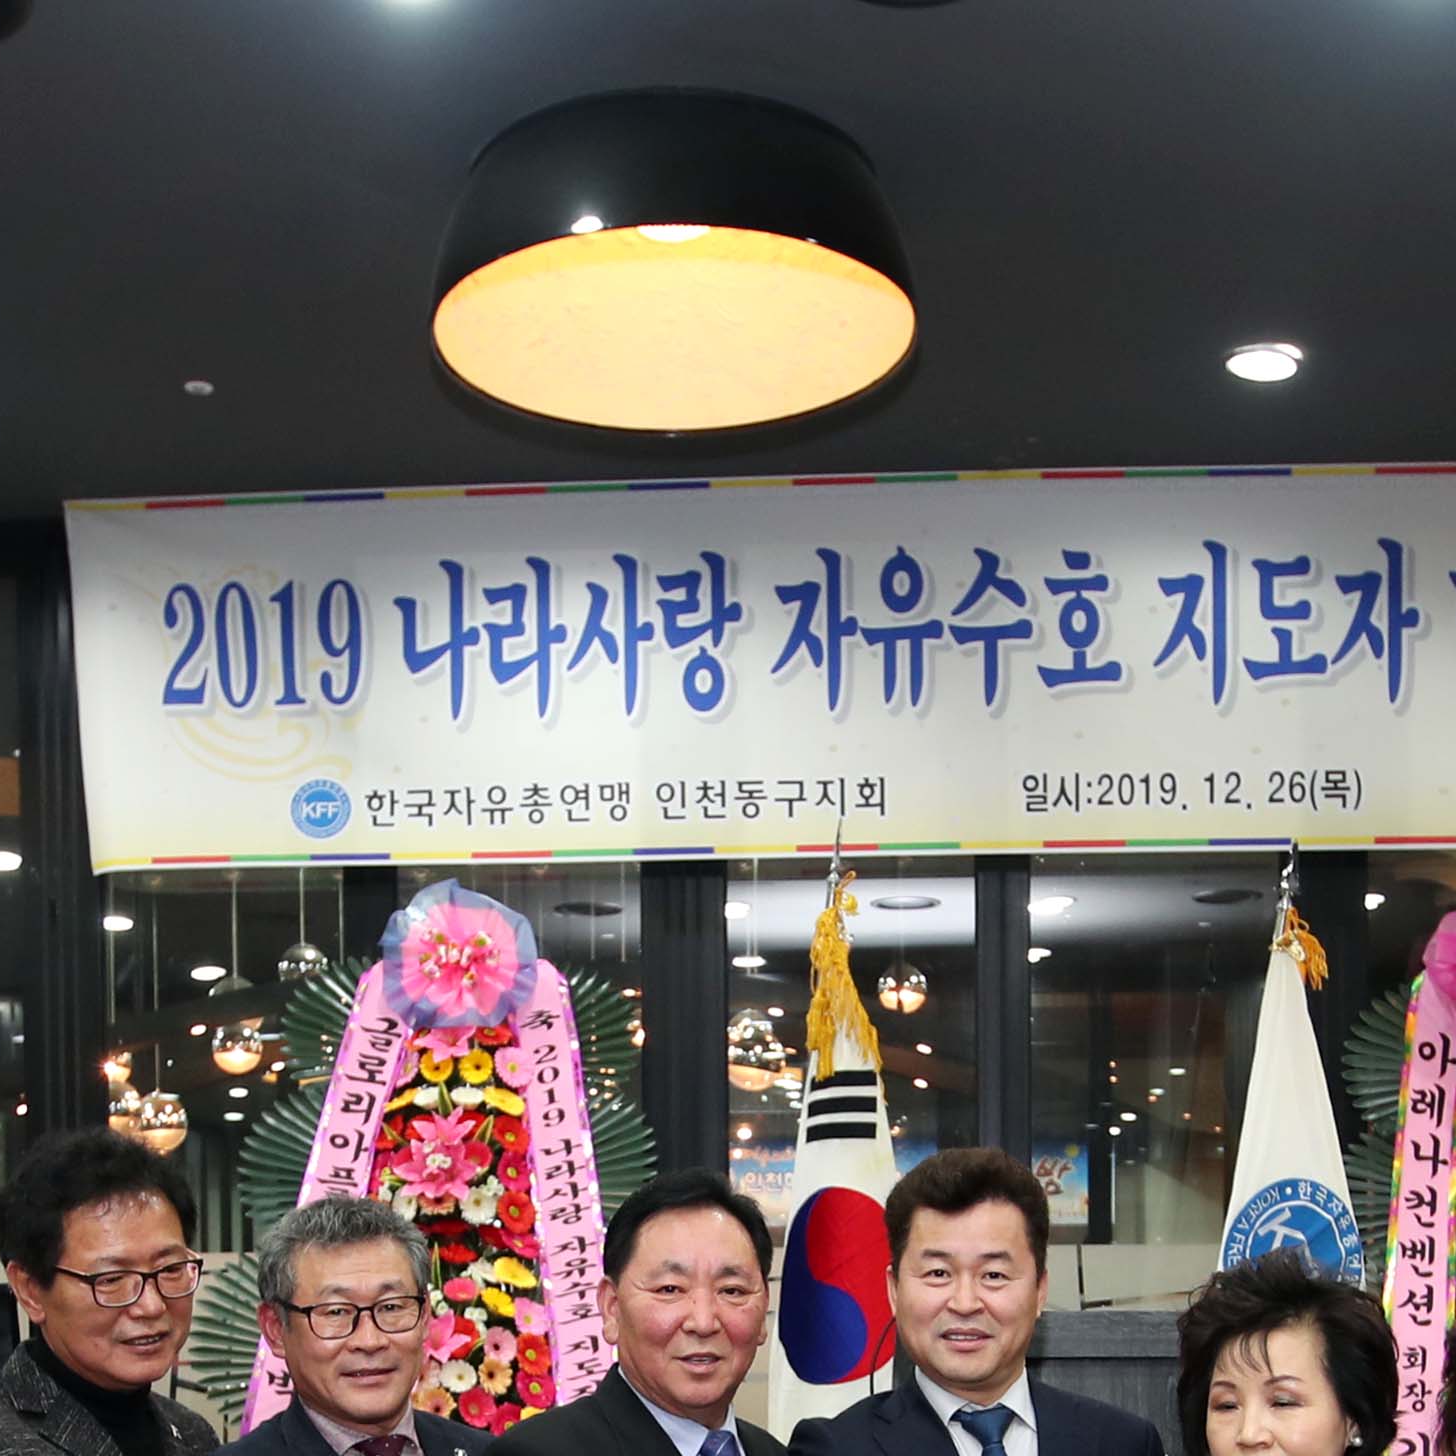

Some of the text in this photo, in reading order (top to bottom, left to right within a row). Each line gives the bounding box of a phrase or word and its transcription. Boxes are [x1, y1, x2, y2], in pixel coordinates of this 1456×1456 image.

[160, 577, 366, 708] 2019
[392, 548, 744, 721] 나라사랑
[770, 545, 1125, 714] 자유수호
[1153, 537, 1420, 706] 지도자
[300, 800, 343, 820] KFF
[365, 782, 633, 829] 한국자유총연맹
[655, 775, 889, 820] 인천동구지회
[1266, 766, 1364, 812] 26(목)
[520, 1010, 561, 1031] 축
[532, 1044, 567, 1128] 2019
[542, 1138, 592, 1225] 나라사랑
[550, 1235, 600, 1325] 자유수호
[1401, 1345, 1432, 1413] 회장
